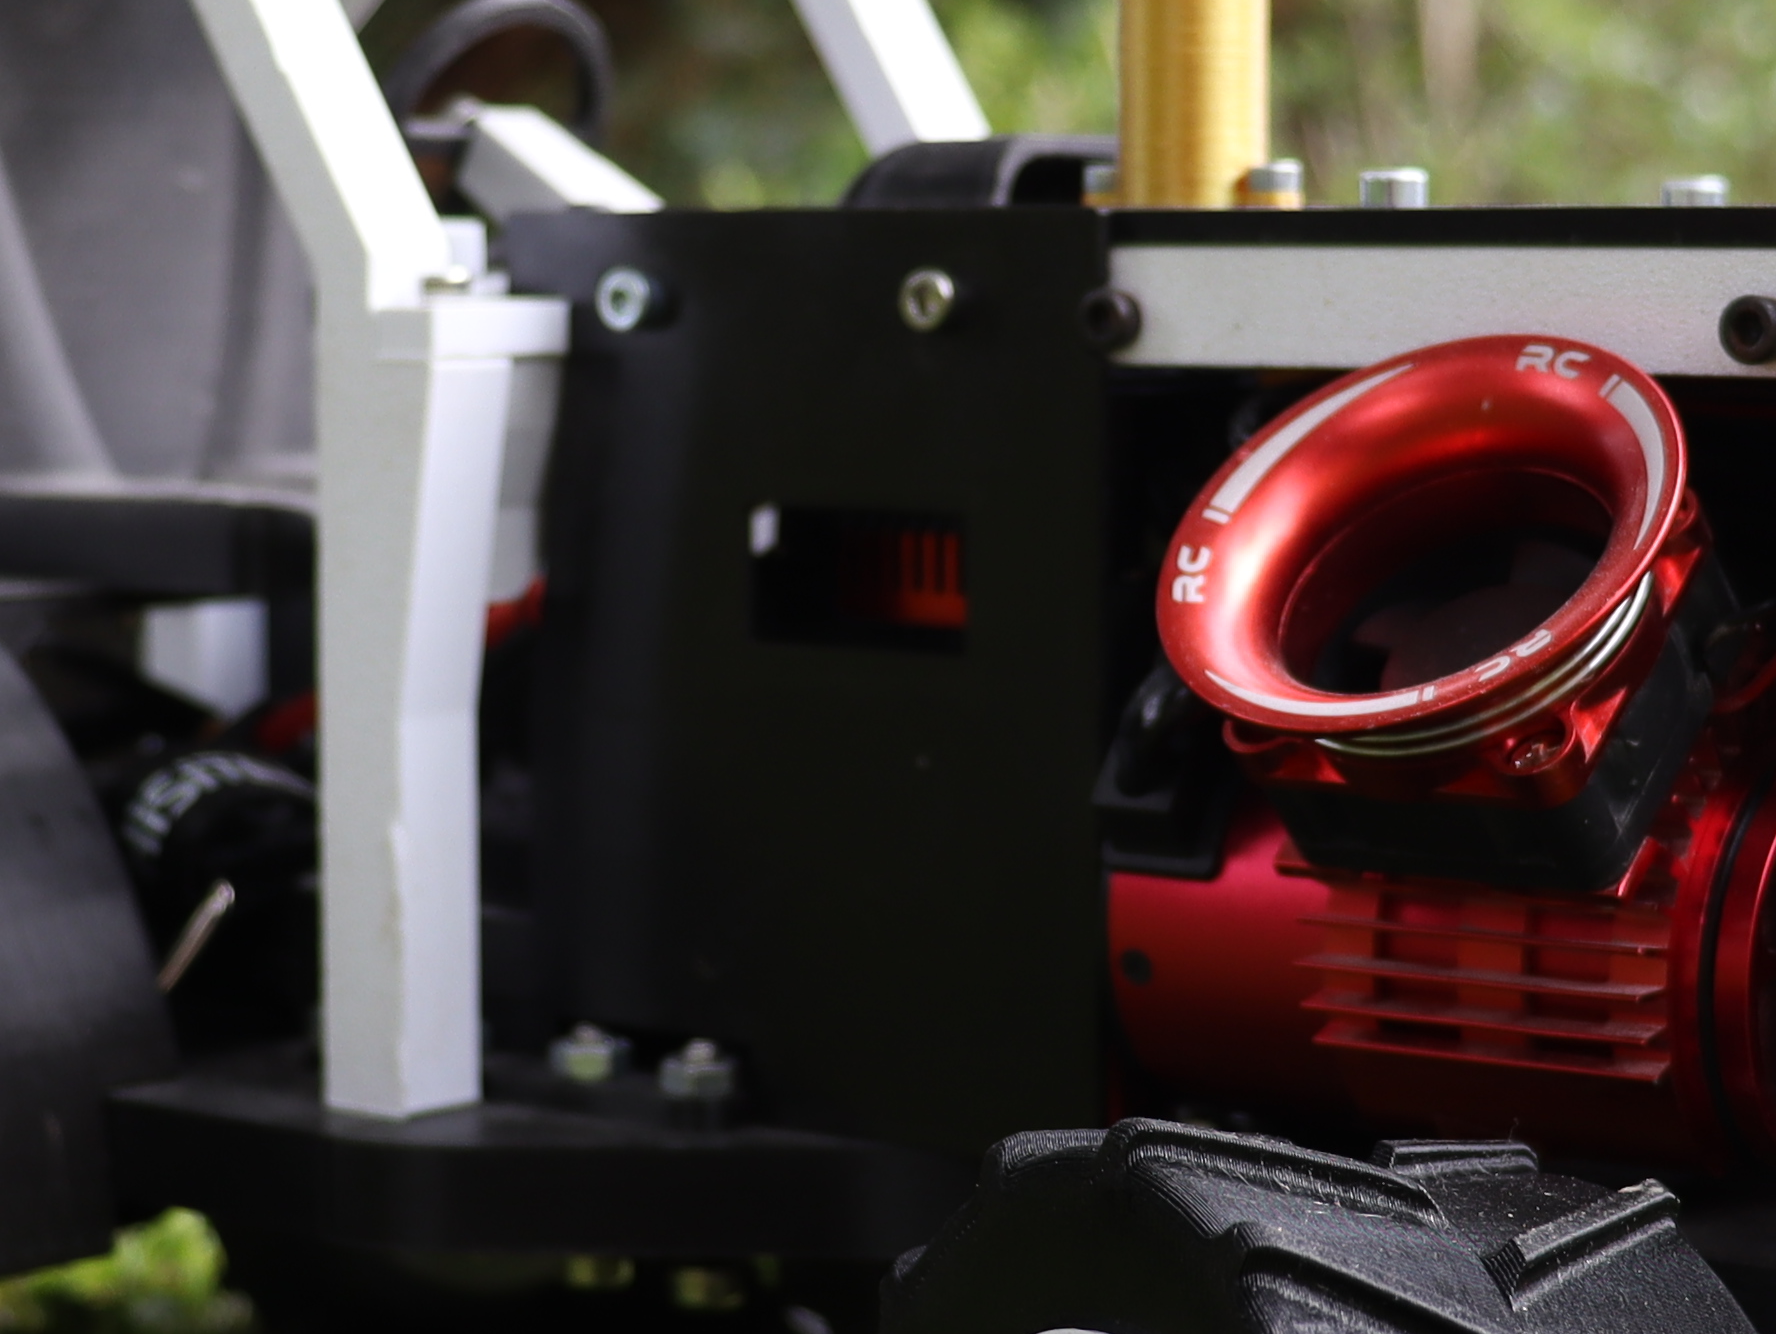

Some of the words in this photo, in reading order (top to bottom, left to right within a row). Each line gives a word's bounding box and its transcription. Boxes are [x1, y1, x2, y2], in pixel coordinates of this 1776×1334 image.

[1515, 344, 1592, 380] RC
[1171, 544, 1212, 603] RC
[1473, 628, 1552, 683] RC
